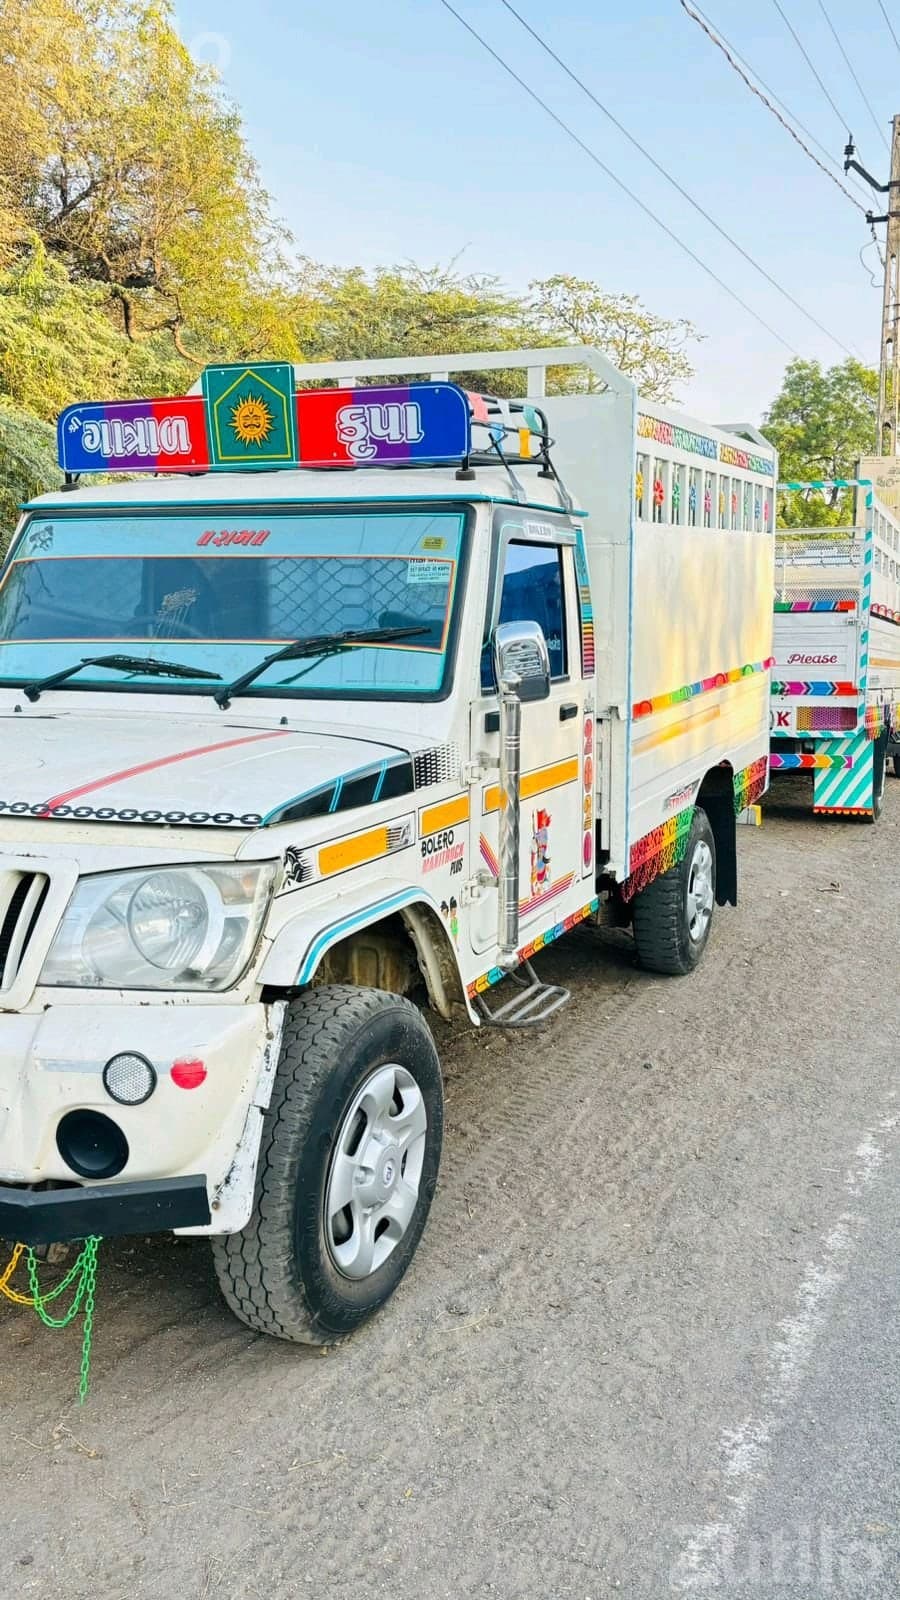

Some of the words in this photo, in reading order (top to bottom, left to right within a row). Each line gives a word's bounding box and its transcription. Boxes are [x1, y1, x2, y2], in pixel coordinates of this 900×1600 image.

[336, 402, 425, 461] કૃપા
[787, 654, 838, 664] Please
[421, 830, 454, 857] BOLERO
[449, 857, 464, 876] PLUS
